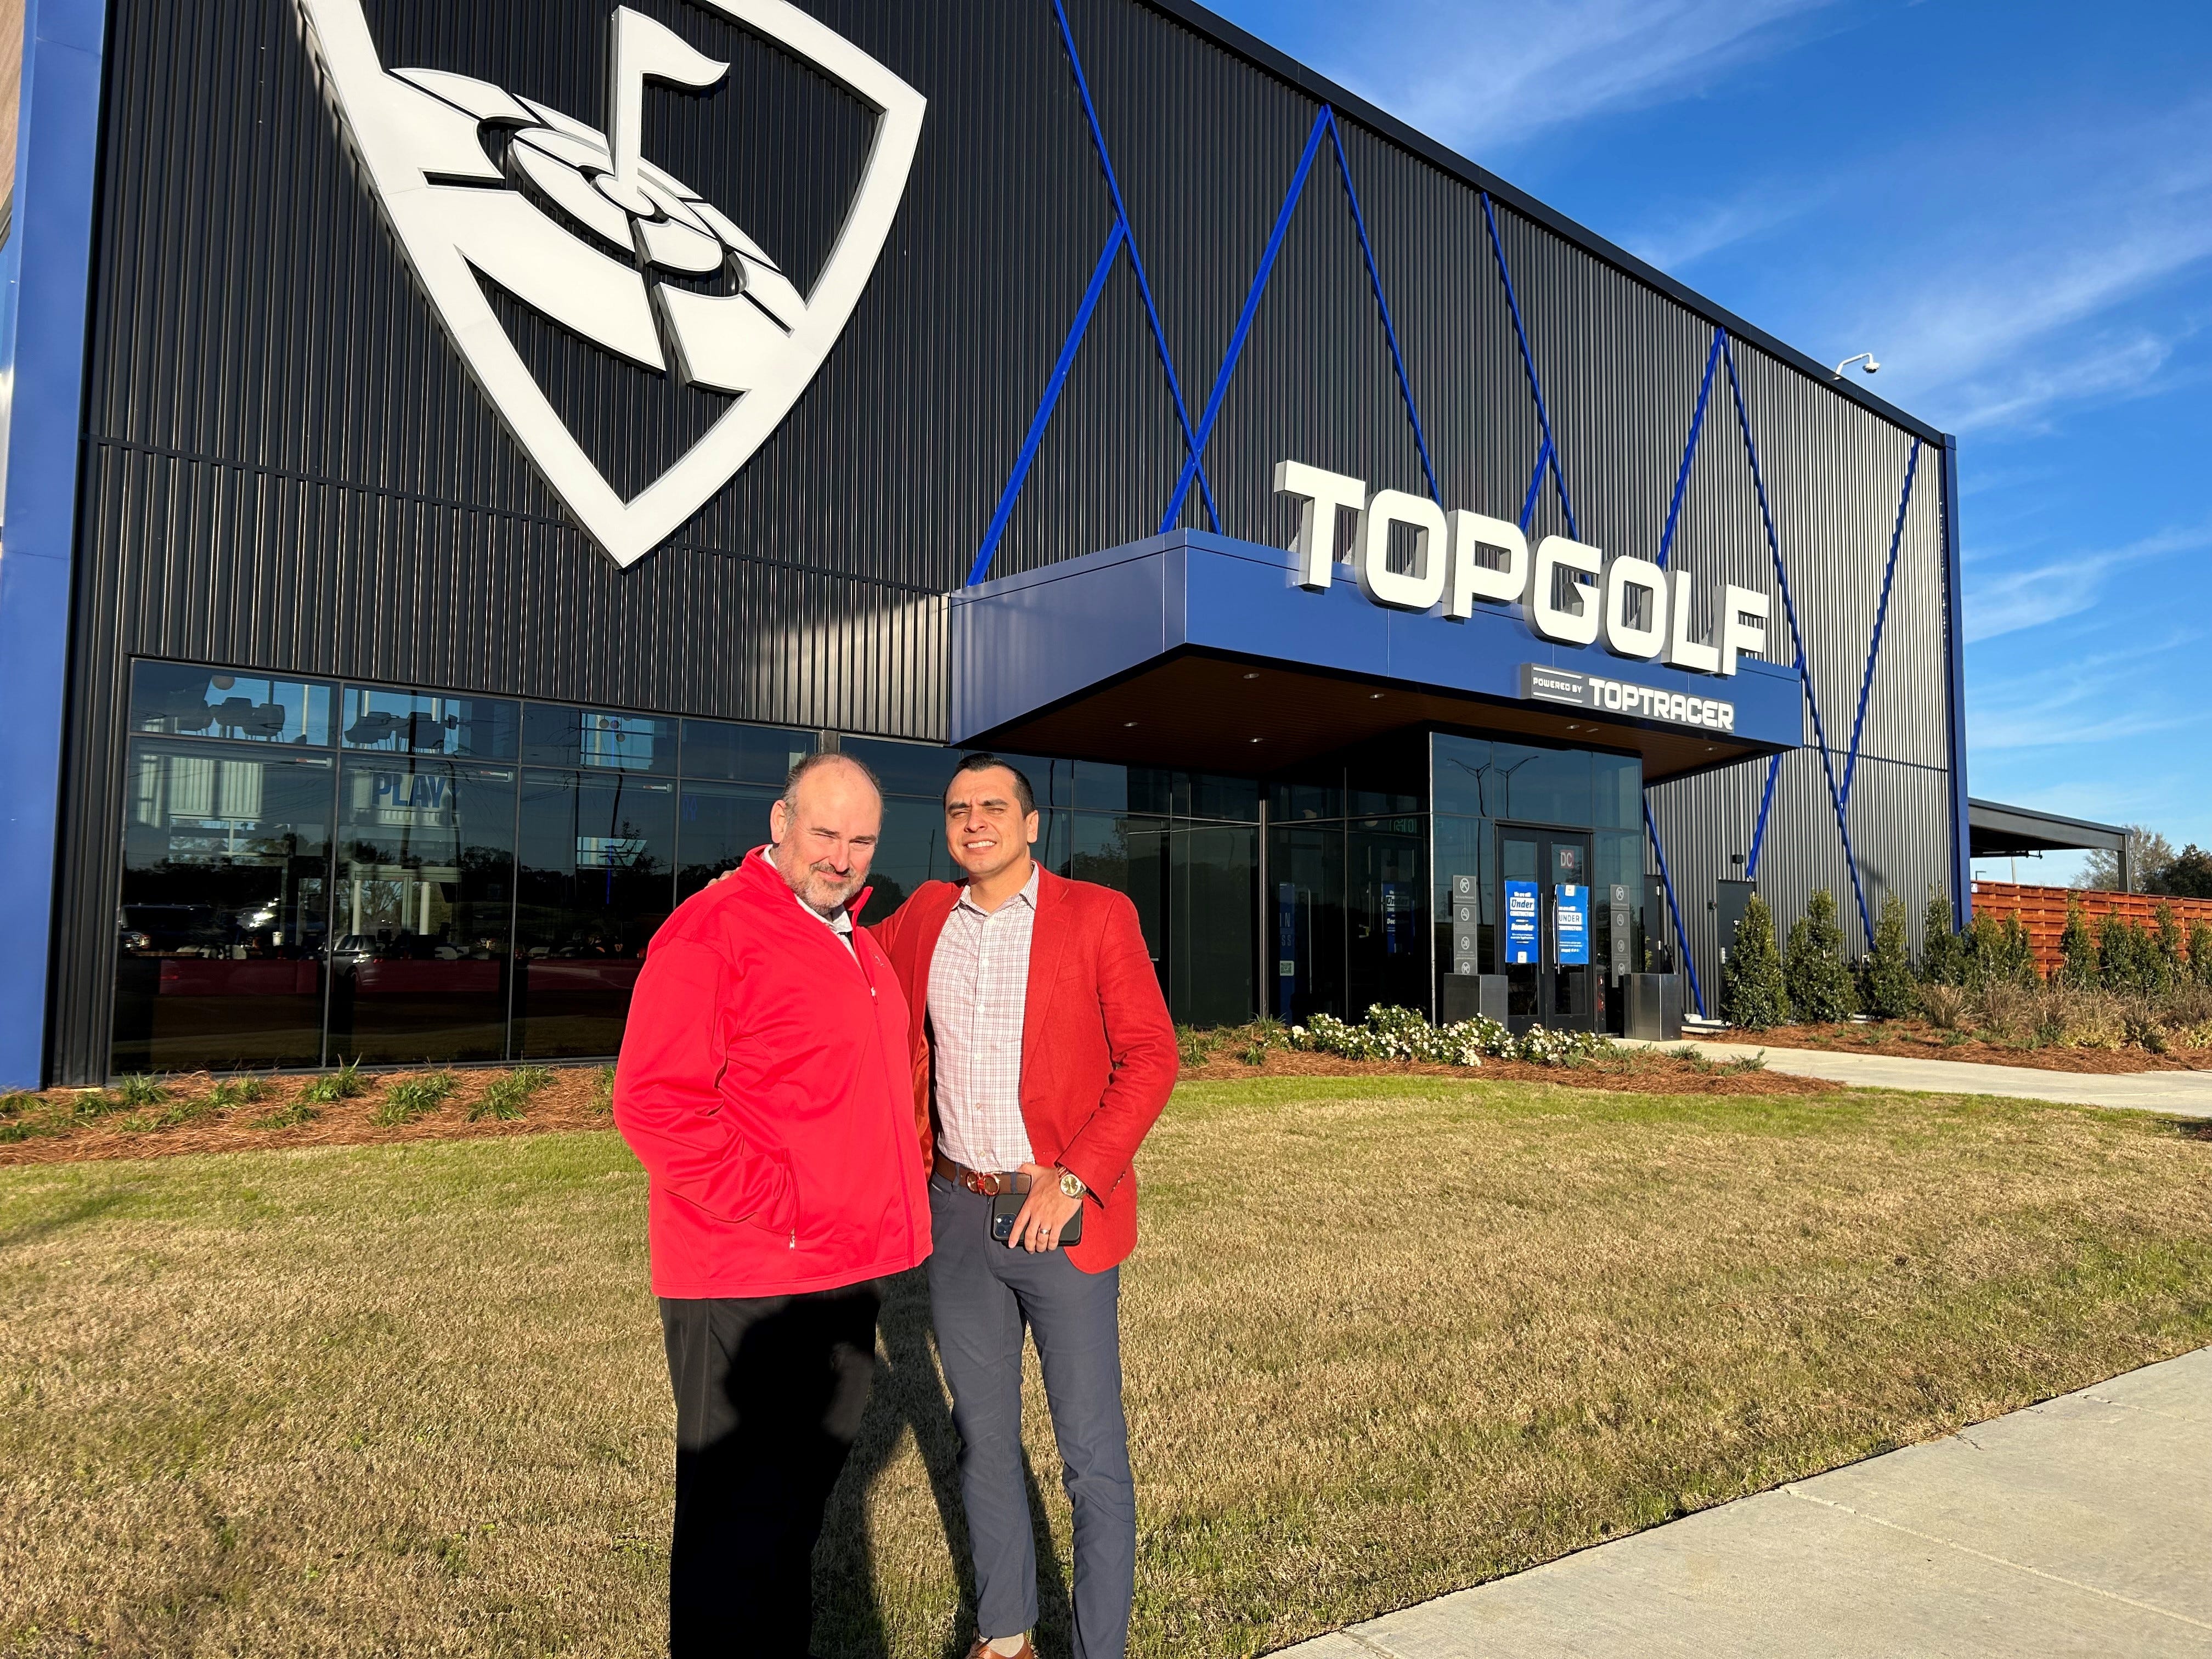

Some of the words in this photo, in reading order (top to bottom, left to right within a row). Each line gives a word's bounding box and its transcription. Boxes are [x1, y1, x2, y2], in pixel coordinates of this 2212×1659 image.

[1274, 460, 1769, 676] TOPGOLF
[1533, 677, 1570, 692] POWERED
[1571, 684, 1582, 693] BY
[1589, 678, 1734, 730] TOPTRACER
[371, 772, 447, 808] PLAY
[1560, 851, 1572, 867] DC
[1511, 899, 1533, 909] Under
[1559, 914, 1580, 922] UNDER
